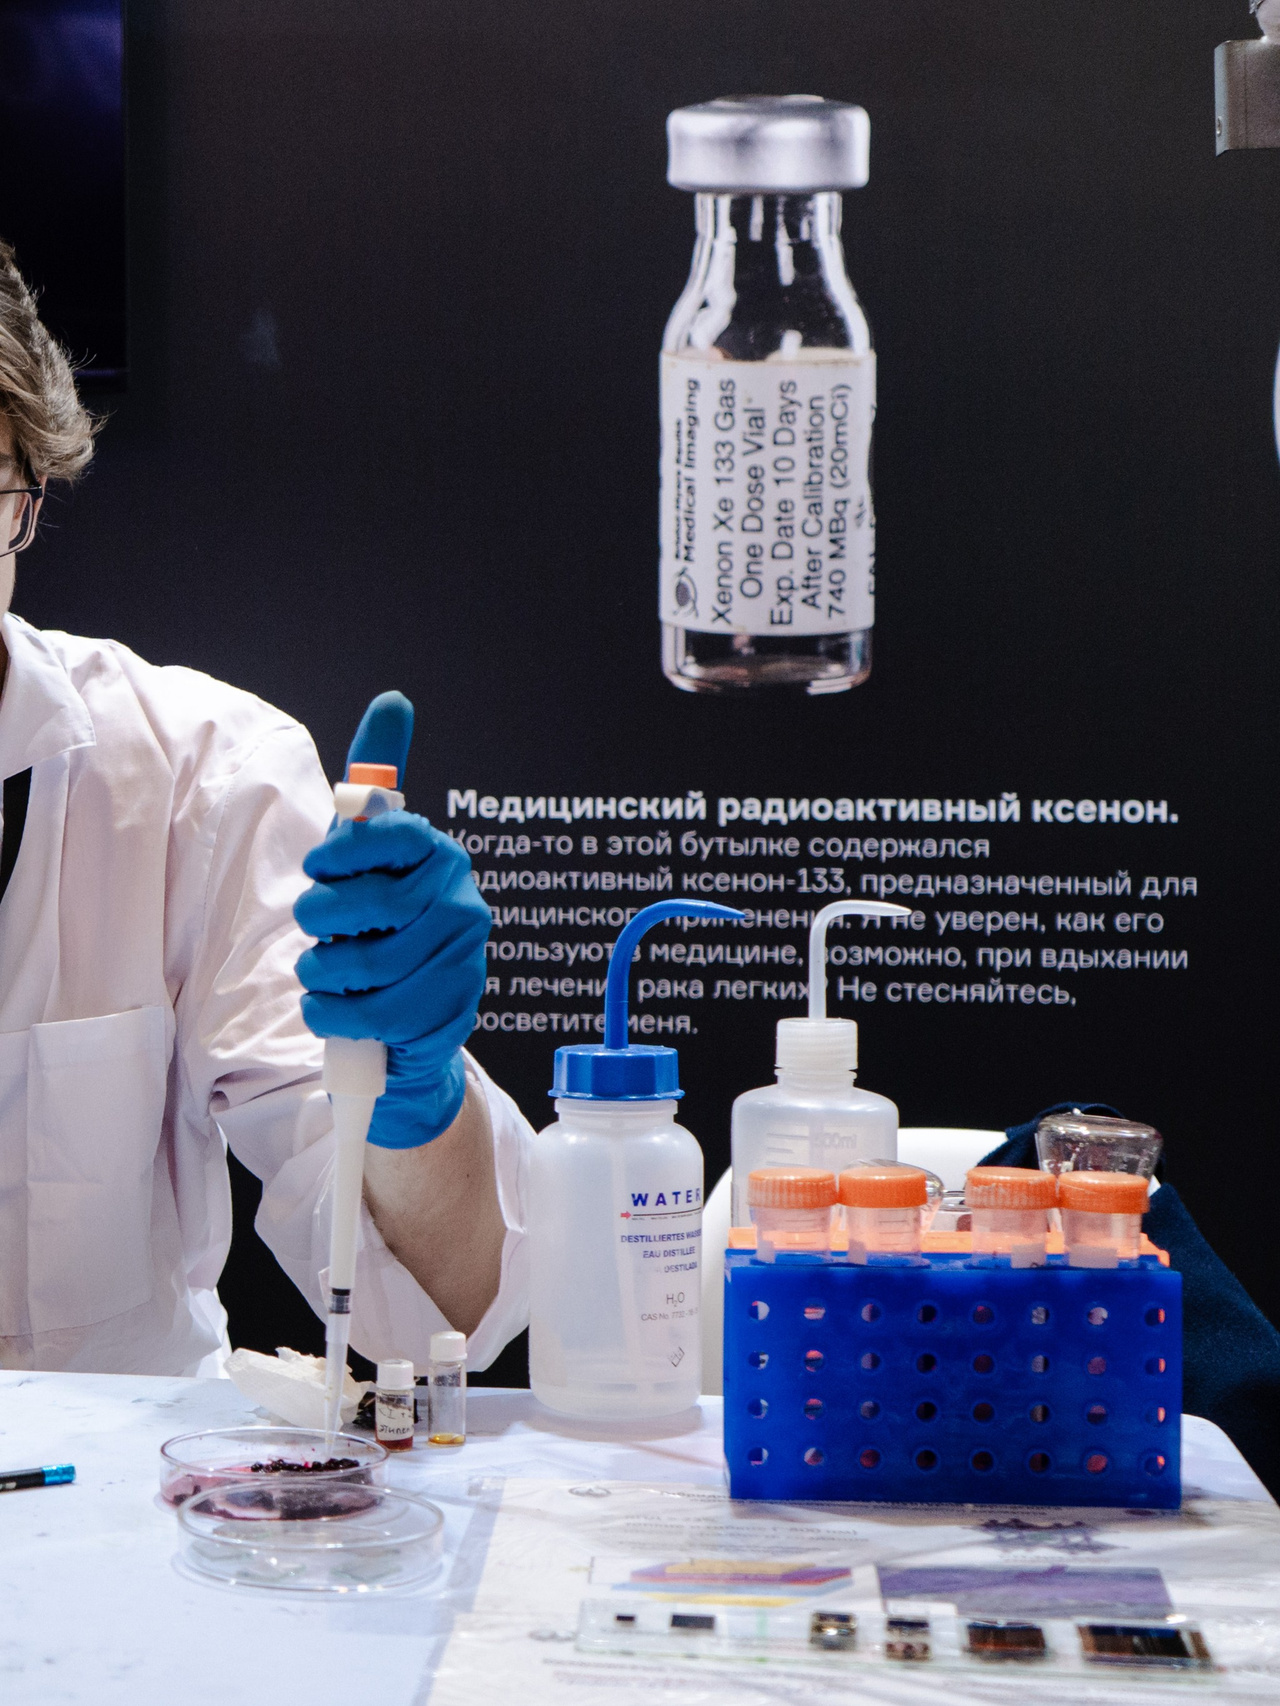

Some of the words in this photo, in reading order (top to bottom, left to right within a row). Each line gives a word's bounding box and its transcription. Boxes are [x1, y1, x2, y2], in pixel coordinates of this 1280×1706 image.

[685, 376, 701, 470] Imaging
[714, 378, 736, 432] Gas
[742, 406, 765, 457] Vial
[773, 379, 802, 447] Days
[714, 440, 735, 486] 133
[829, 383, 852, 489] (20mCi)
[772, 456, 796, 487] 10
[801, 395, 825, 538] Calibration
[684, 477, 696, 563] Medical
[712, 497, 734, 532] Xe
[740, 464, 765, 533] Dose
[770, 498, 795, 561] Date
[828, 498, 850, 560] MBq
[711, 540, 734, 625] Xenon
[739, 543, 763, 600] One
[769, 570, 798, 627] Exp.
[801, 546, 823, 610] After
[827, 568, 847, 619] 740
[447, 788, 707, 824] Медицинский
[718, 791, 1021, 827] радиоактивный
[1031, 799, 1179, 824] ксенон.
[581, 835, 599, 855] в
[606, 829, 672, 856] этой
[681, 829, 801, 862] бутылке
[808, 836, 990, 863] содержался
[471, 865, 673, 893] адиоактивный
[682, 867, 852, 896] ксенон-133,
[861, 869, 1132, 900] предназначенный
[1139, 875, 1198, 900] для
[489, 906, 641, 929] дицинског
[891, 910, 927, 931] не
[934, 910, 1047, 936] уверен,
[1056, 911, 1106, 933] как
[1114, 912, 1165, 934] его
[484, 941, 617, 966] пользуют
[650, 942, 804, 968] медицине,
[976, 947, 1032, 973] при
[1041, 948, 1189, 972] вдыхании
[508, 976, 609, 997] лечени
[637, 977, 704, 1003] рака
[713, 979, 828, 1001] легких
[837, 976, 878, 1002] Не
[885, 977, 1077, 1007] стесняйтесь,
[475, 1011, 607, 1033] осветите
[628, 1014, 699, 1035] меня.
